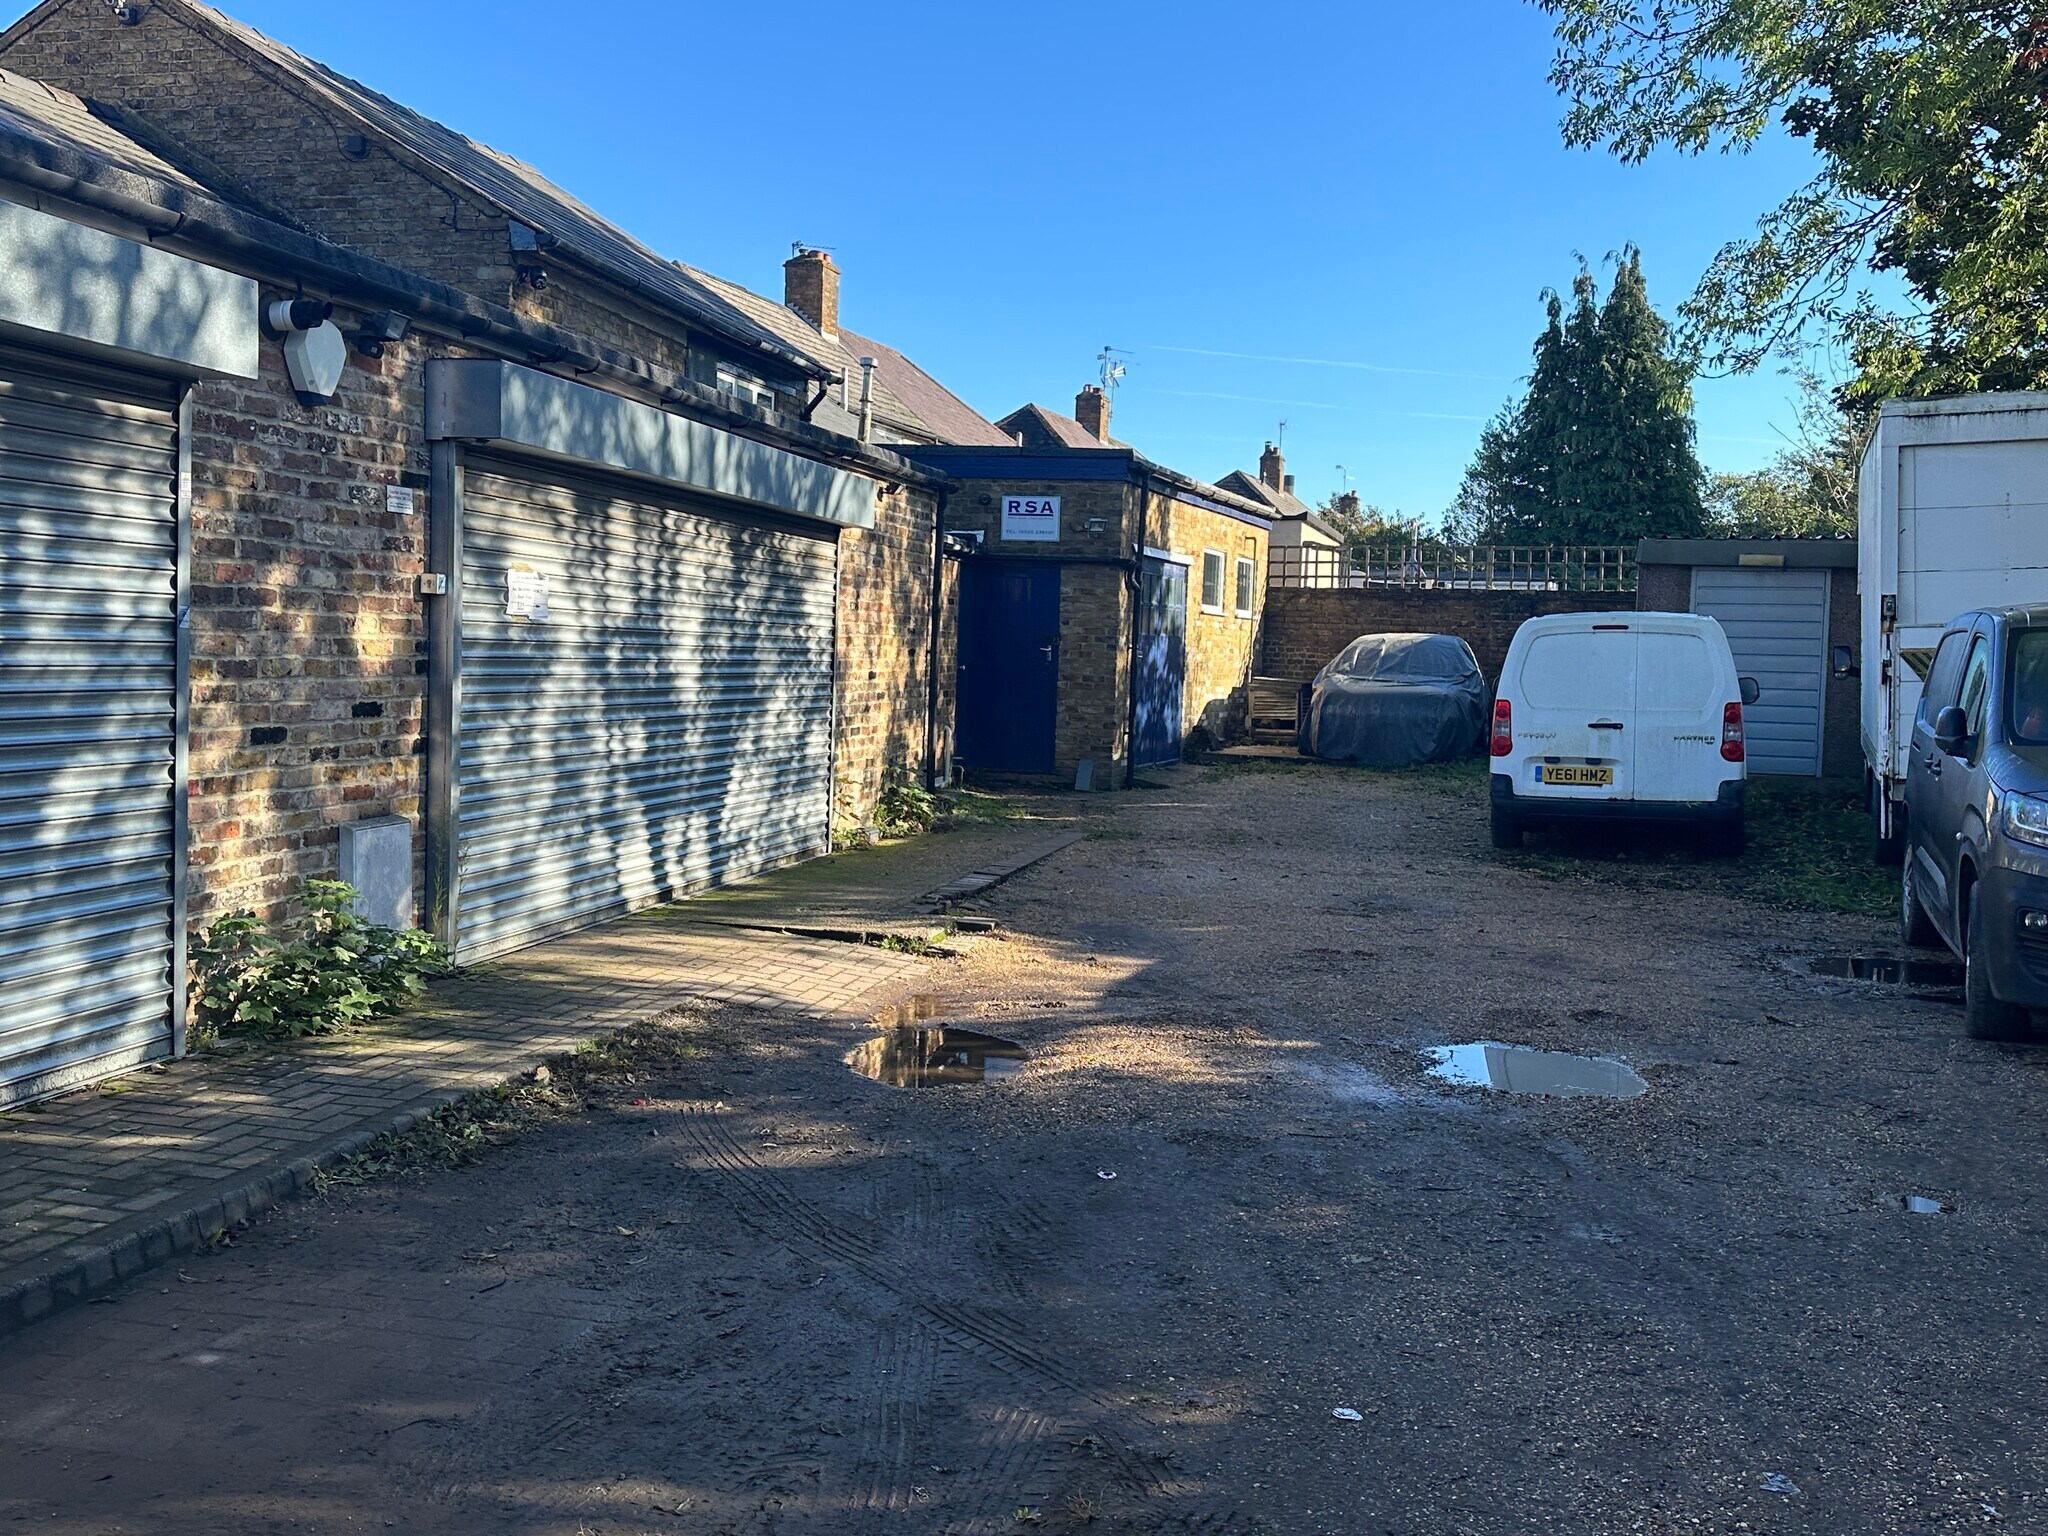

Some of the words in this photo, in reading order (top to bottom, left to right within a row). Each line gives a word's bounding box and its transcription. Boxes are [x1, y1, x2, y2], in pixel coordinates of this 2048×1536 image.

[1008, 500, 1054, 513] RSA
[1546, 768, 1577, 781] YE61
[1580, 769, 1608, 782] HMZ
